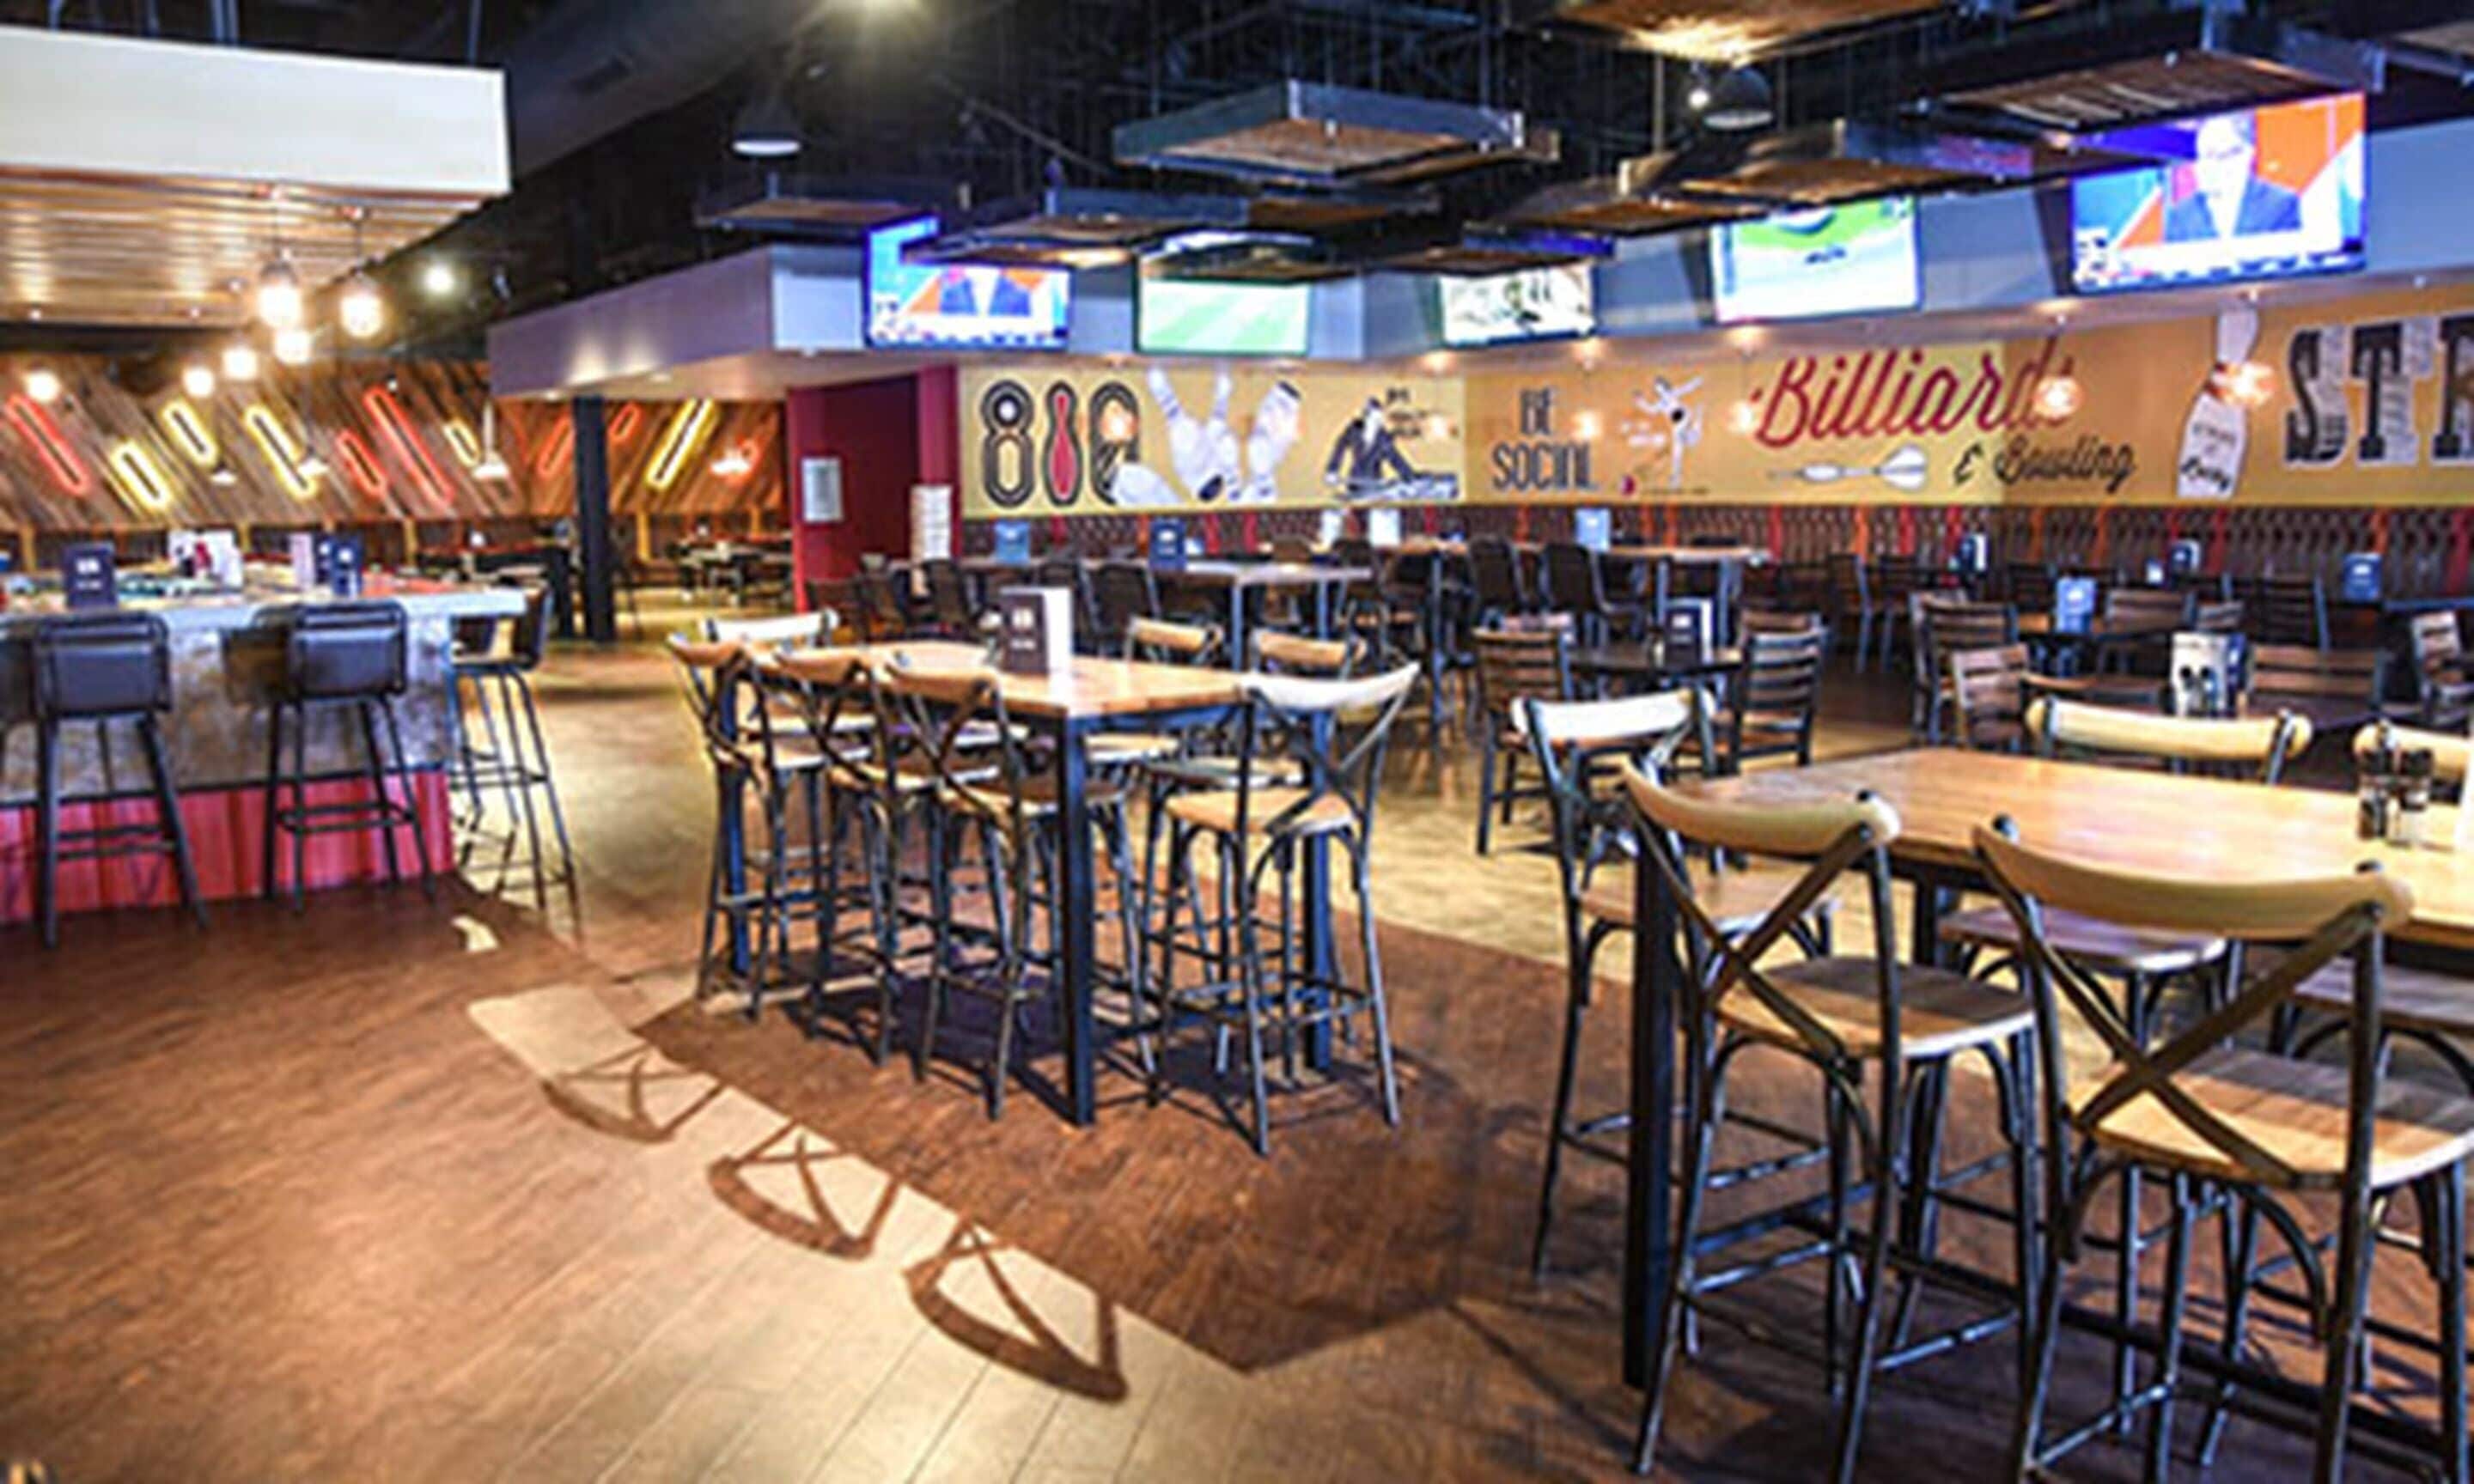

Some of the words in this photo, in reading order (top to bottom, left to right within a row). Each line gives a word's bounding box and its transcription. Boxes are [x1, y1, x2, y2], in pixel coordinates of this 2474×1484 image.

[1519, 387, 1551, 435] BE
[1491, 441, 1598, 492] SOCIAL
[1993, 433, 2137, 496] Bowling
